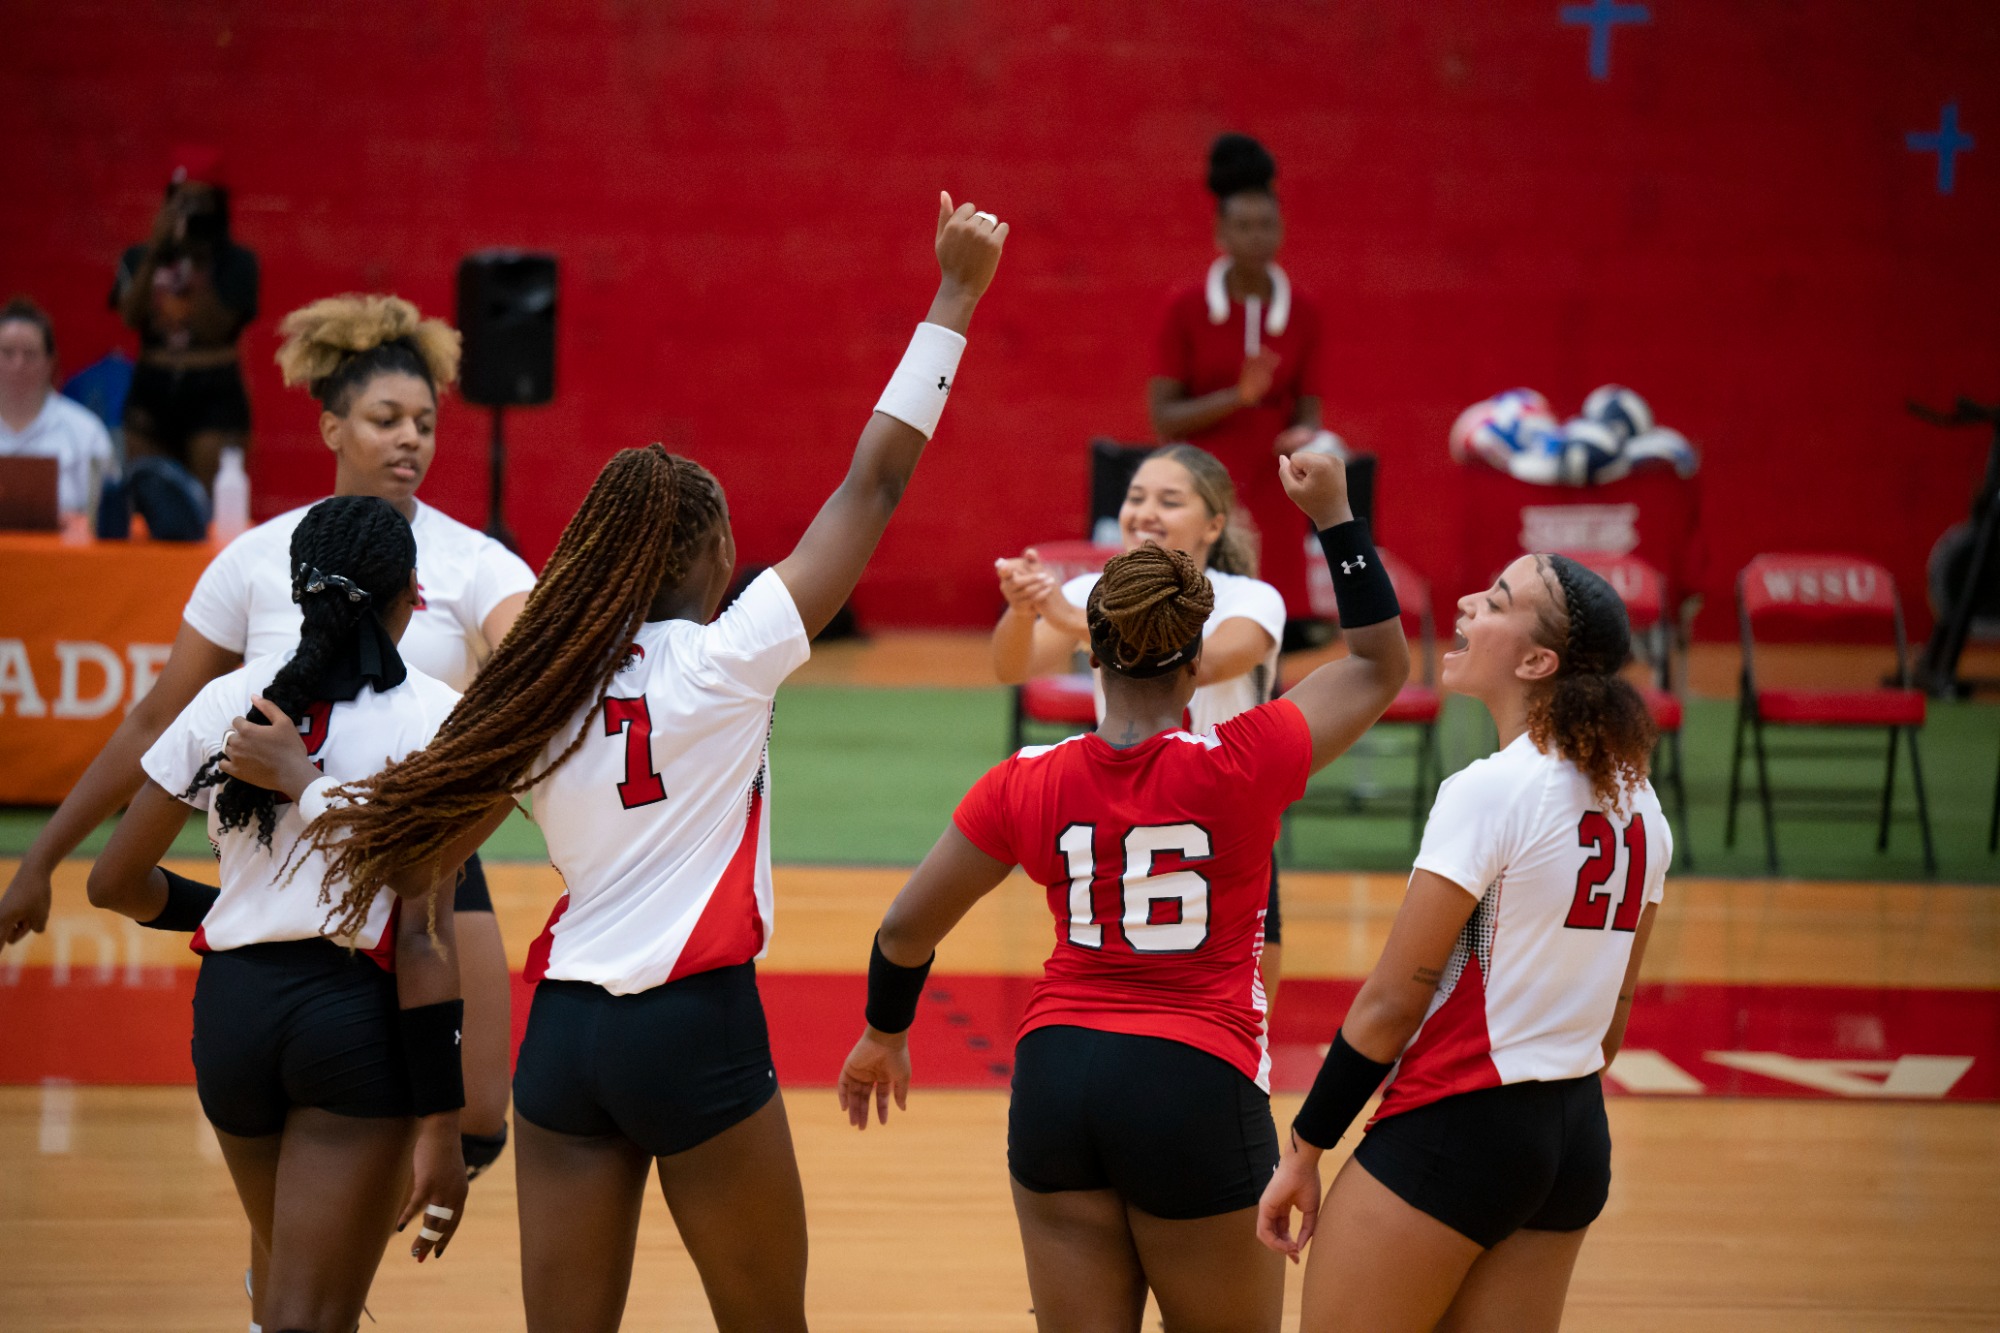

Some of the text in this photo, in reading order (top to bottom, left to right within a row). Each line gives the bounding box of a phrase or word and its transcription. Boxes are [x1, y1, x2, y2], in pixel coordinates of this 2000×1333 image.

[604, 693, 668, 810] 7
[1056, 820, 1214, 954] 16
[1562, 810, 1647, 932] 21
